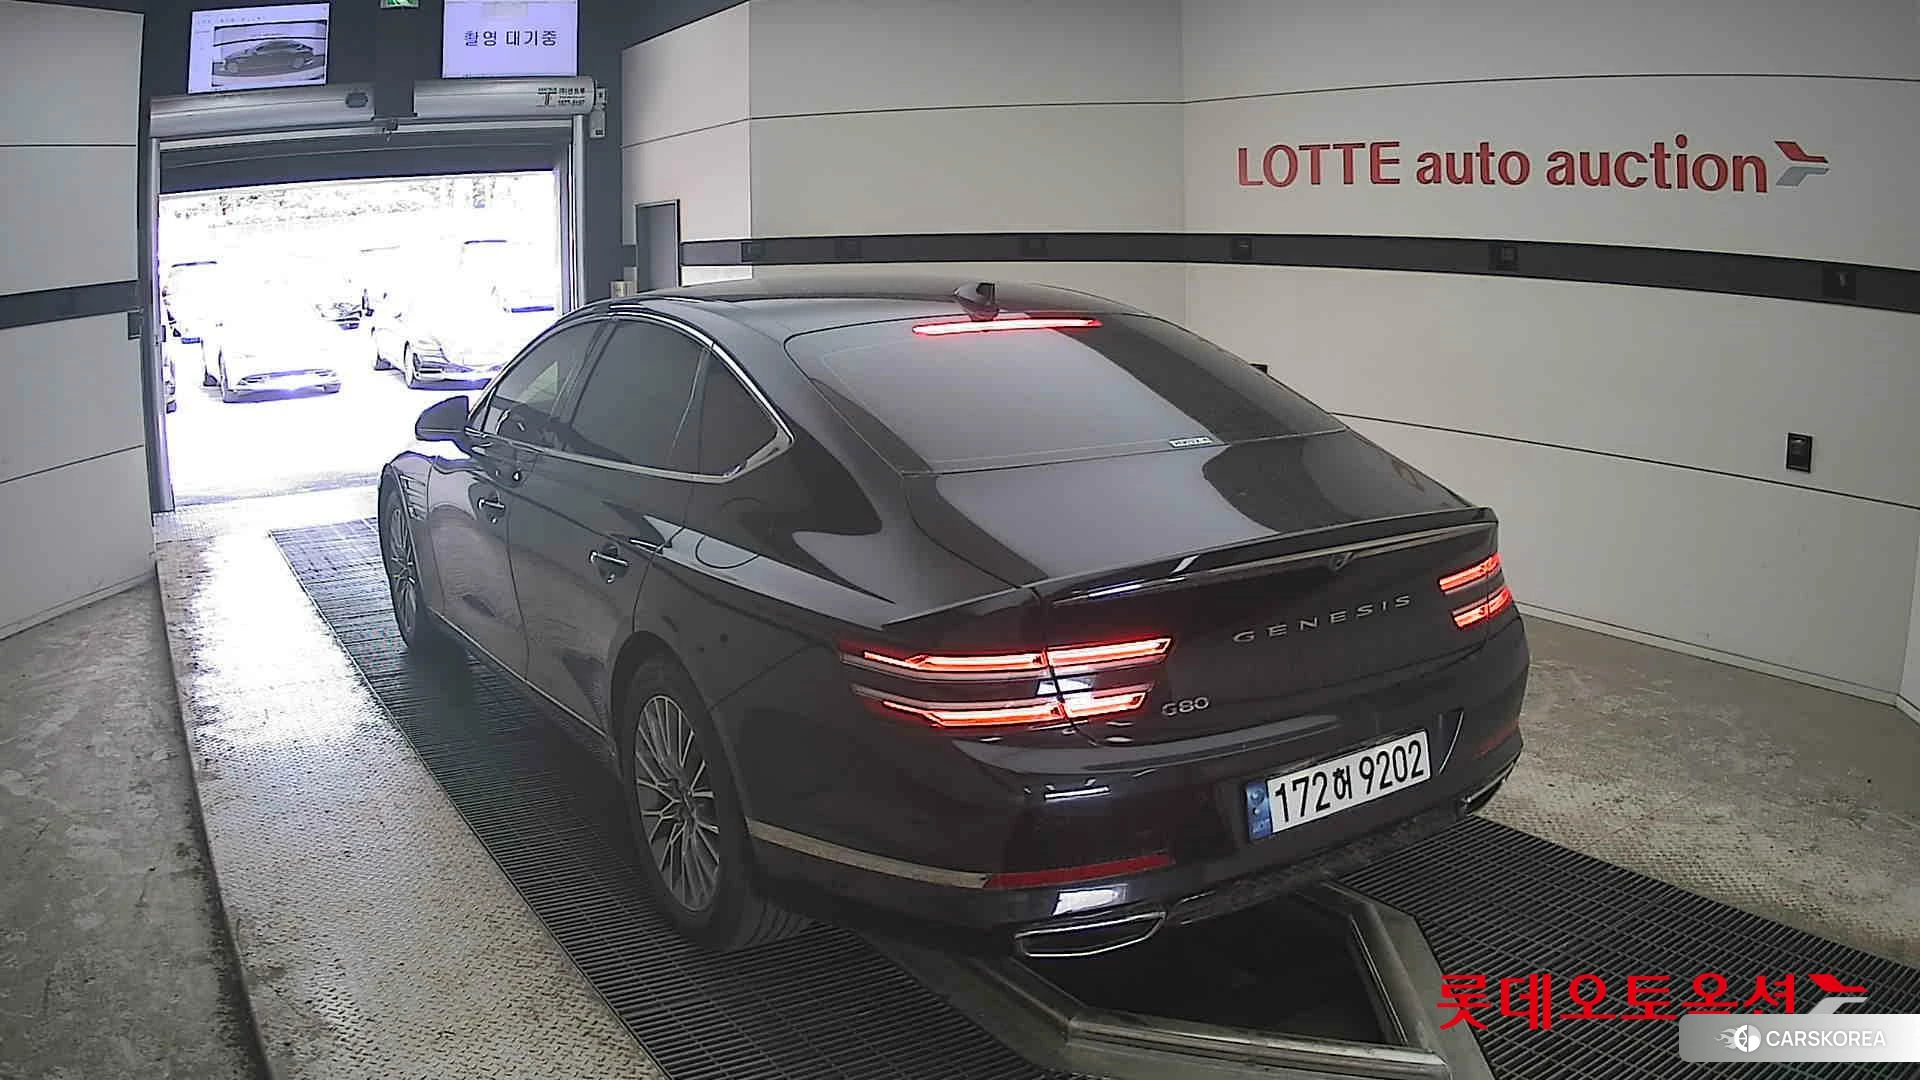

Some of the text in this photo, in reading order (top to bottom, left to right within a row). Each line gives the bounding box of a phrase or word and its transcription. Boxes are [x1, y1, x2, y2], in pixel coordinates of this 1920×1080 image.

[505, 30, 558, 47] 대기중
[1237, 134, 1768, 193] LOTTE auto auction
[1232, 594, 1411, 643] GENESIS
[1161, 696, 1210, 717] G80
[1274, 740, 1425, 823] 172허 9202
